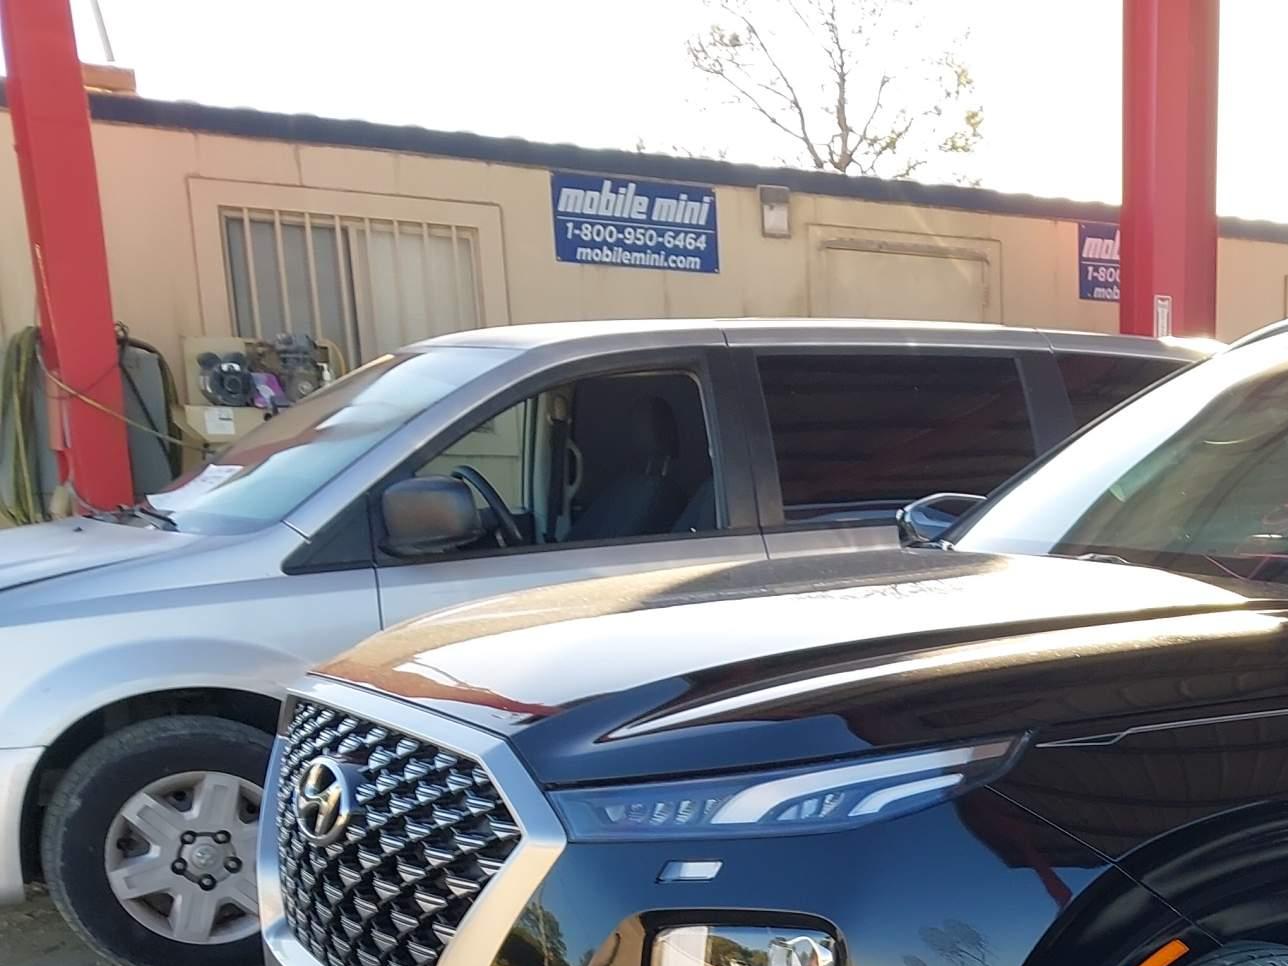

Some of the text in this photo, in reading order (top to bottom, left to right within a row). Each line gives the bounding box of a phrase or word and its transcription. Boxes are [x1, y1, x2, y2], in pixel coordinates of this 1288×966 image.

[557, 180, 712, 225] mobile mini
[566, 222, 707, 250] 1-800-950-6464
[576, 246, 701, 270] mobilemini.com
